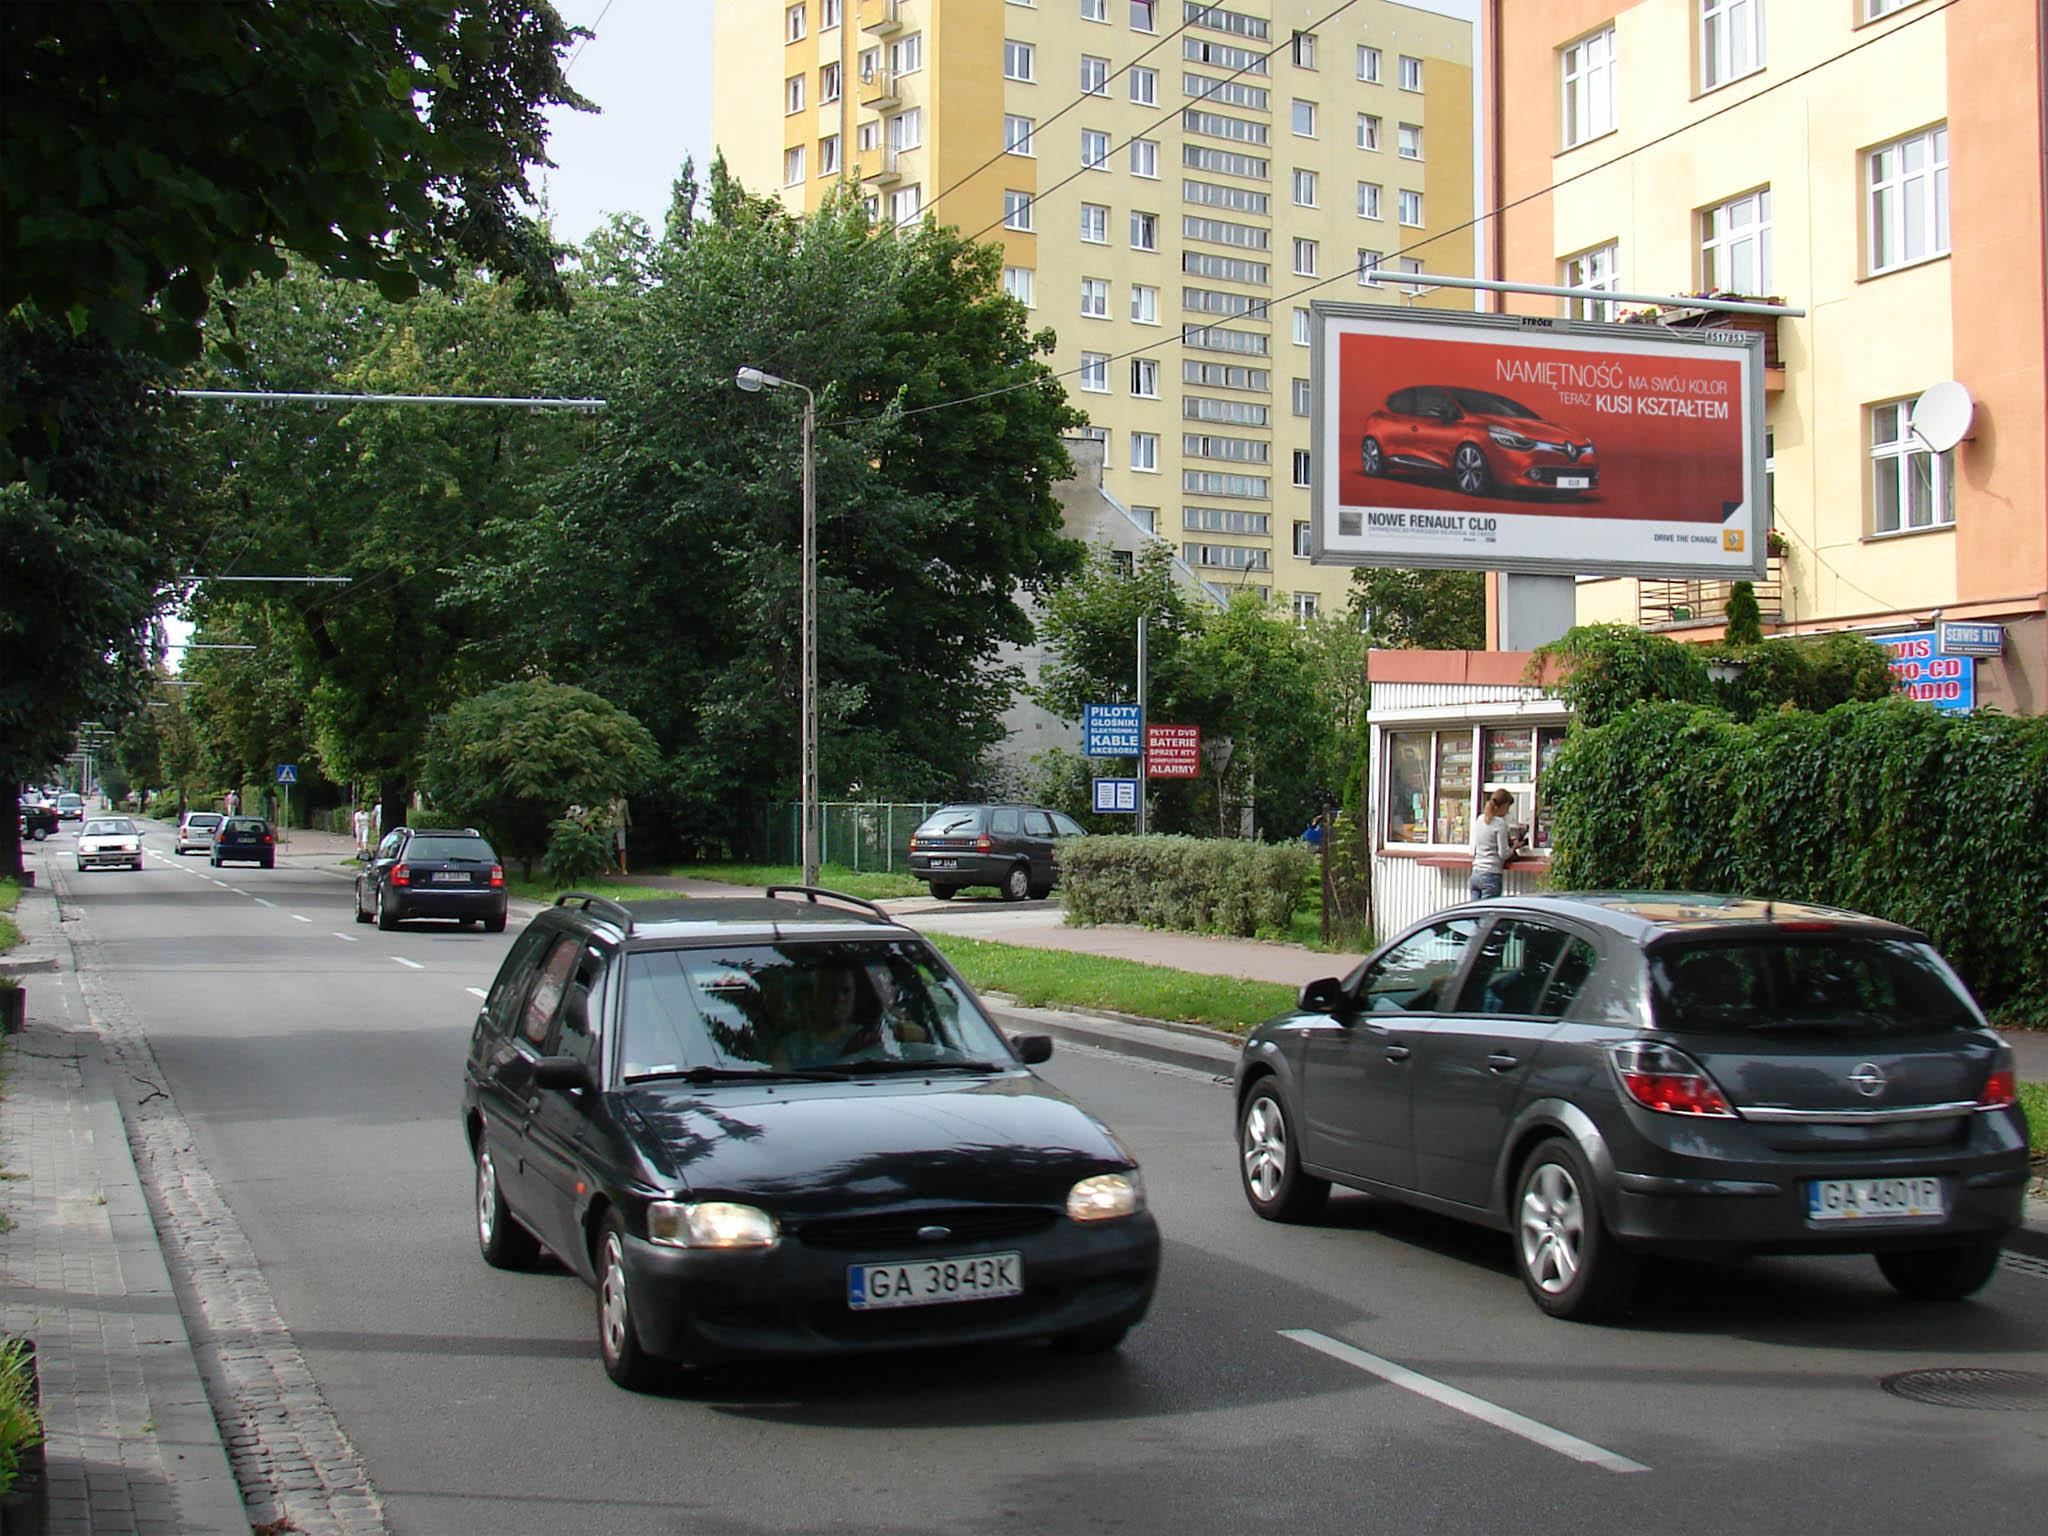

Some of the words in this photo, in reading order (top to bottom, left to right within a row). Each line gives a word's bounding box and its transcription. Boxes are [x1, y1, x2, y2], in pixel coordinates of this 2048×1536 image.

[1496, 358, 1623, 391] NAMIĘTNOŚĆ
[1628, 375, 1649, 391] MA
[1651, 376, 1686, 393] SWÓJ
[1689, 379, 1728, 395] KOLOR
[1559, 391, 1592, 406] TERAZ
[1596, 395, 1632, 414] KUSI
[1637, 396, 1729, 420] KSZTAŁTEM
[1368, 512, 1406, 527] NOWE
[1410, 514, 1465, 530] RENAULT
[1469, 517, 1497, 532] CLIO
[1654, 533, 1674, 543] DRIVE
[1676, 534, 1689, 543] THE
[1690, 535, 1718, 544] CHANGE
[1946, 628, 1980, 642] SERWIS
[1982, 629, 2001, 643] RTV
[1091, 707, 1138, 717] PILOTY
[1177, 729, 1197, 737] DVD
[1091, 735, 1138, 746] KABLE
[1150, 738, 1196, 747] BATERIE
[1150, 764, 1196, 774] ALARMY
[869, 1267, 913, 1298] GA
[925, 1257, 1014, 1293] 3843K
